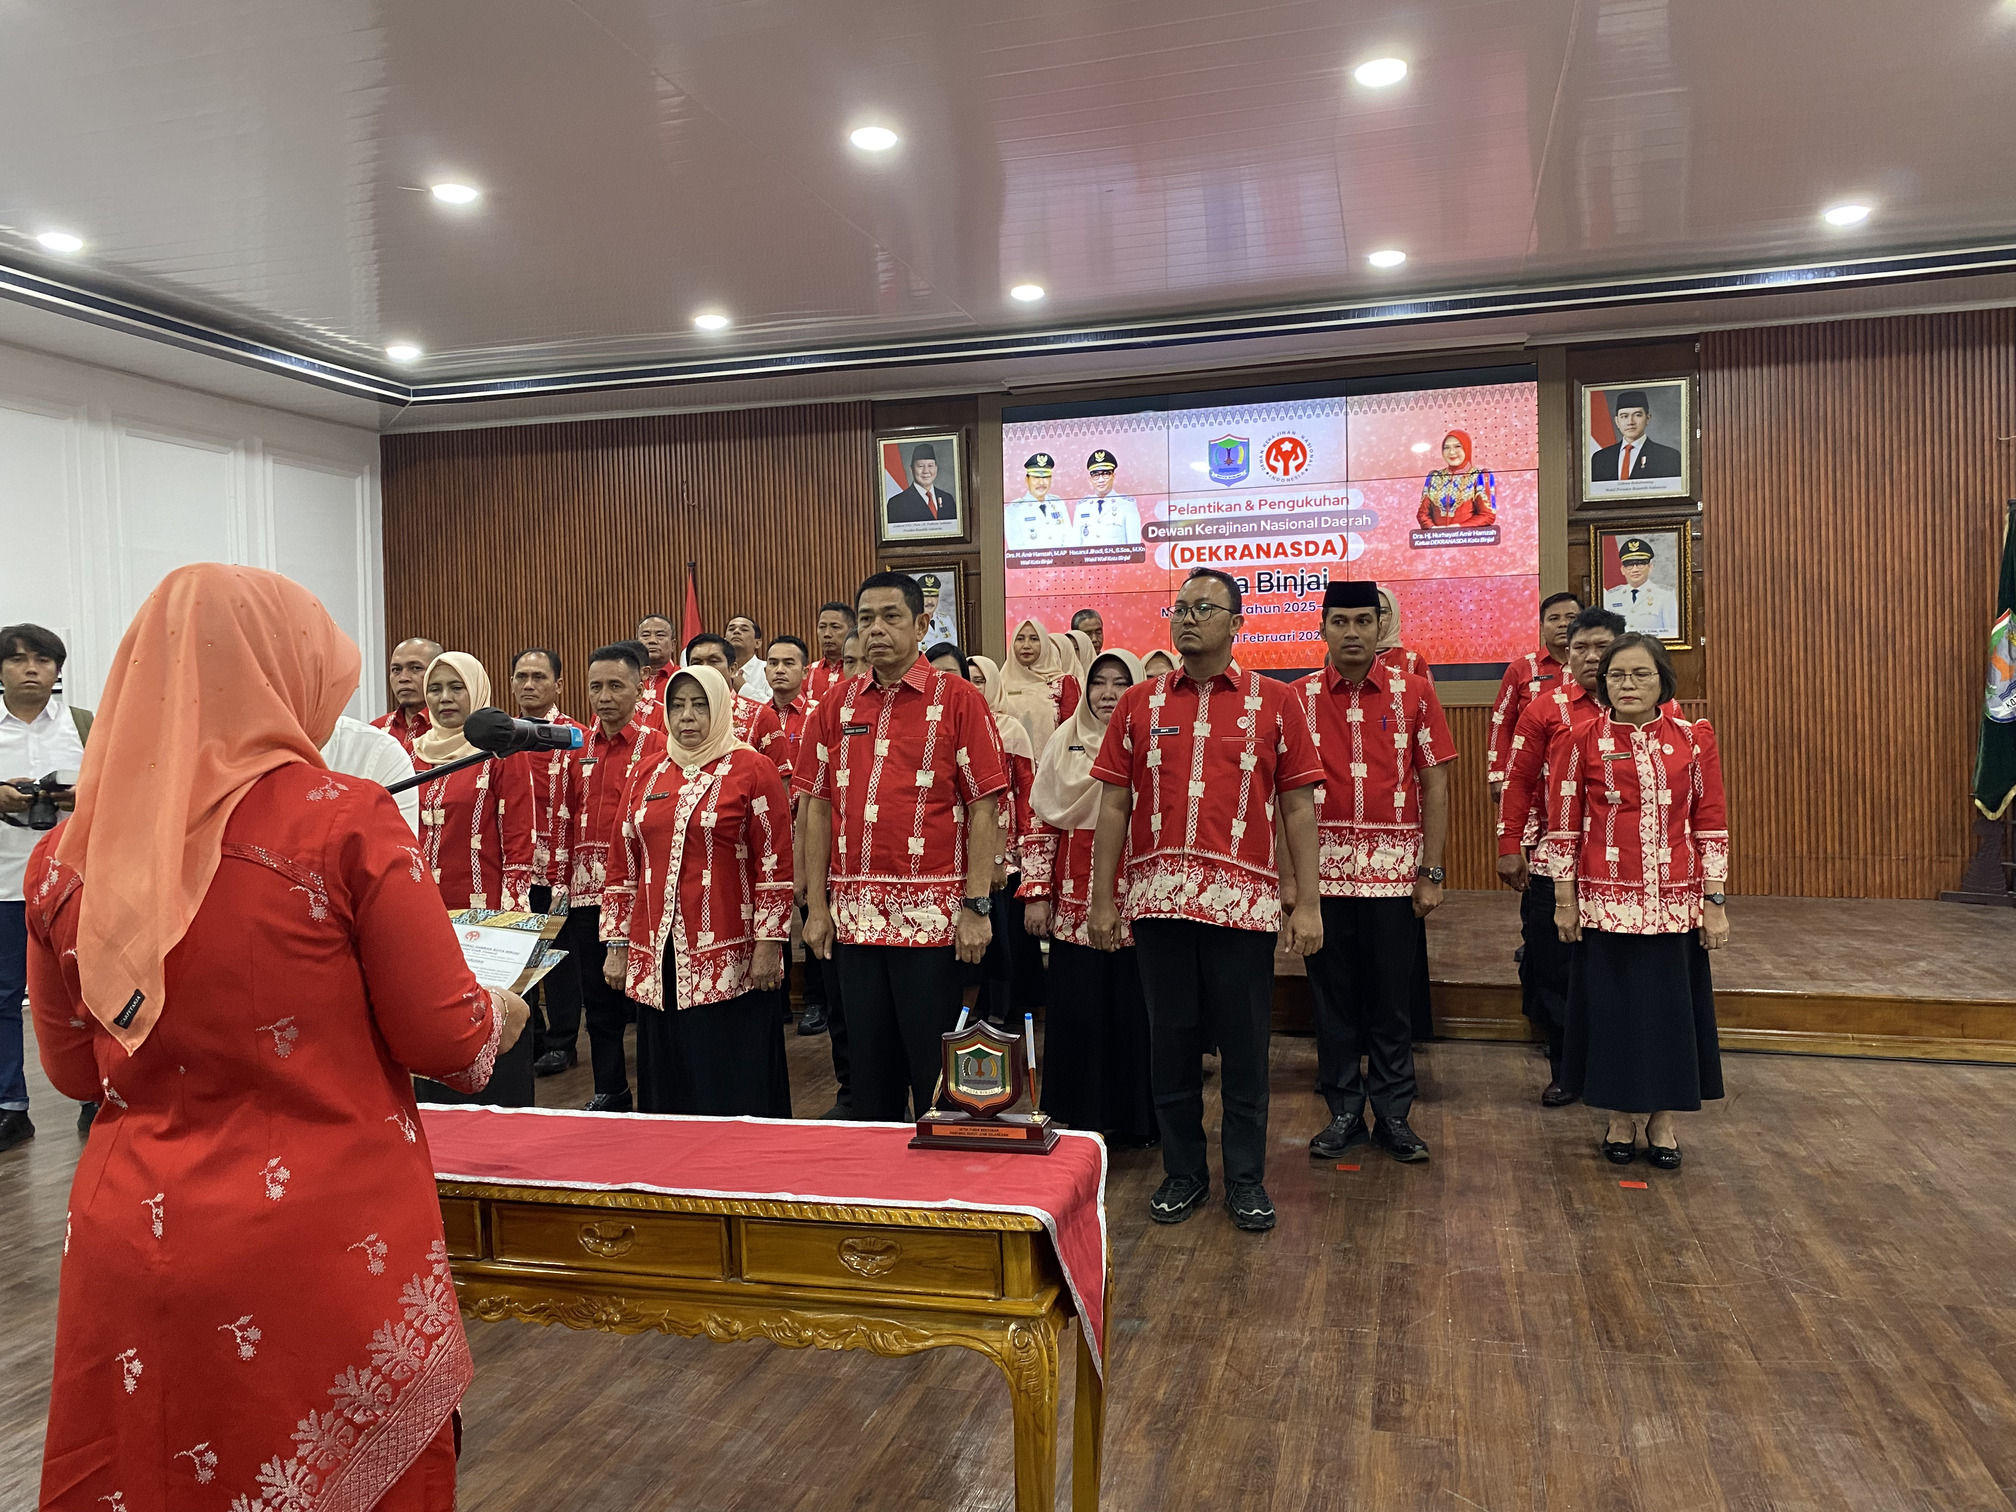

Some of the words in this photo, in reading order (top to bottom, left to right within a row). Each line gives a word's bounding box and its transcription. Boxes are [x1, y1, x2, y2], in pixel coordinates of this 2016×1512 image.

[1168, 500, 1241, 516] Pelantikan
[1245, 500, 1255, 511] &
[1258, 495, 1349, 513] Pengukuhan
[1148, 523, 1193, 538] Dewan
[1195, 520, 1258, 536] Kerajinan
[1260, 516, 1318, 532] Nasional
[1321, 514, 1371, 528] Daerah
[1170, 534, 1348, 568] (DEKRANASDA)
[1257, 568, 1328, 597] Binjai
[1243, 631, 1295, 643] Februari
[1299, 631, 1320, 641] 202
